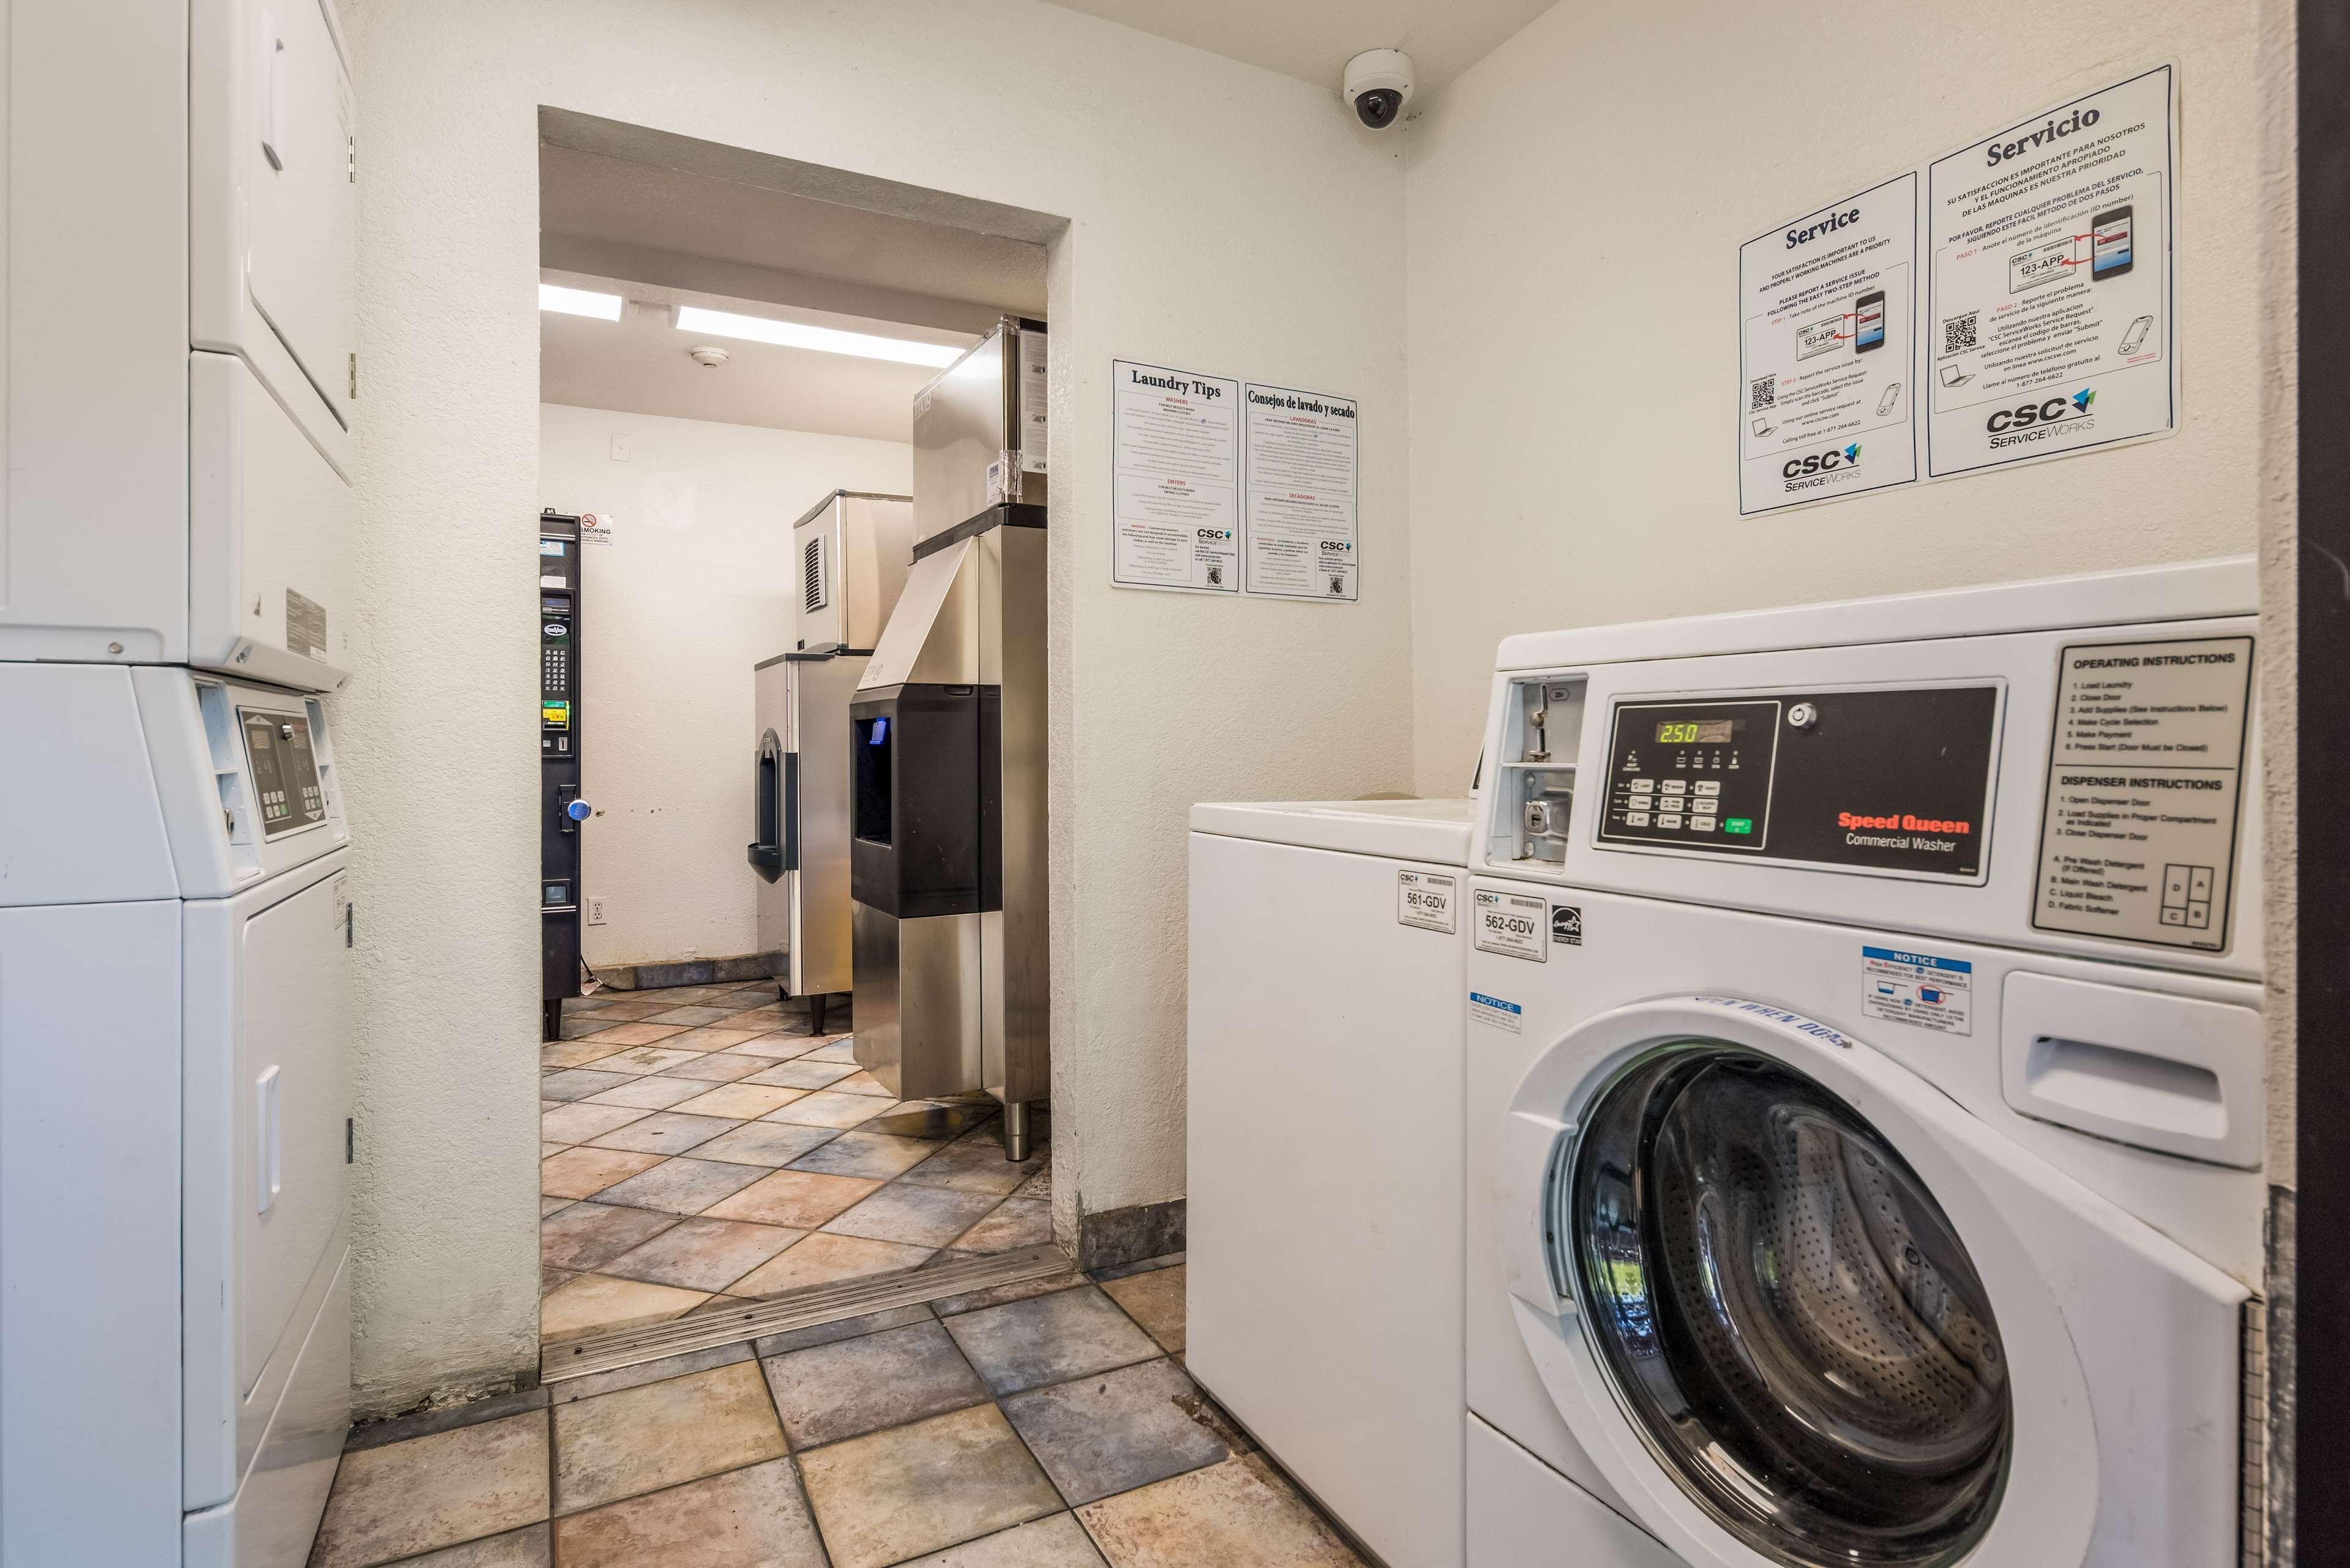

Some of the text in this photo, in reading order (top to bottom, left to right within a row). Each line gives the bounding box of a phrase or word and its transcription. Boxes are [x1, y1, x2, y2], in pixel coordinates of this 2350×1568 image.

[1986, 109, 2100, 167] Servicio
[1947, 122, 2145, 206] SU SATISFACCION ES IMPORTANTE PARA NOSOTROS
[1963, 149, 2125, 217] DE LAS MAQUINAS ES NUESTRA PRIORIDAD
[1974, 146, 2111, 203] Y EL FUNCIONAMIENTO APROPIADO
[1949, 168, 2143, 243] POR FAVOR, REPORTE CUALQUIER PROBLEMA DEL SERVICIO,
[1967, 184, 2120, 244] SIGUIENDO ESTE FACIL METODO DE DOS PASOS
[1786, 209, 1860, 249] Service
[1759, 284, 1769, 293] AND
[1770, 275, 1794, 289] PROPERLY
[1795, 265, 1819, 279] WORKING
[1820, 255, 1847, 270] MACHINES
[1848, 250, 1858, 259] ARE
[1865, 238, 1891, 253] PRIORITY
[1772, 271, 1784, 280] YOUR
[1785, 257, 1821, 275] SATISFACTION
[1827, 243, 1858, 259] IMPORTANT
[2011, 255, 2027, 264] CSC
[2020, 255, 2064, 275] 123-APP
[1767, 272, 1880, 316] FOLLOWING THE EASY TWO-STEP METHOD
[1779, 293, 1797, 305] PLEASE
[1798, 285, 1819, 297] REPORT
[1825, 275, 1847, 288] SERVICE
[1849, 269, 1866, 280] ISSUE
[1772, 316, 1782, 325] STEP
[1825, 296, 1847, 307] machine
[1853, 286, 1876, 297] number
[1805, 330, 1836, 346] 123-APP
[1983, 381, 2000, 389] Llame
[2007, 373, 2032, 383] número
[2041, 365, 2065, 375] teléfono
[2067, 358, 2092, 370] gratuito
[2016, 372, 2063, 388] 1-877-264-6622
[1132, 370, 1221, 400] Laundry Tips
[1248, 390, 1355, 419] Consejos de lavado y secado
[1836, 401, 1855, 410] request
[1802, 413, 1839, 426] www.cscsw.com
[1986, 397, 2067, 433] CSC
[1823, 420, 1860, 433] 1-877-264-6622
[1783, 450, 1840, 479] CSC
[1197, 529, 1224, 539] CSC
[1320, 541, 1344, 551] CSC
[2074, 654, 2235, 668] OPERATING INSTRUCTIONS
[2101, 681, 2133, 689] Laundry
[2095, 706, 2127, 714] Supplies
[2128, 706, 2148, 714] (See
[2175, 744, 2208, 753] Closed)
[2061, 776, 2222, 790] DISPENSER INSTRUCTIONS
[1838, 812, 1970, 834] Speed Queen
[1846, 833, 1956, 852] Commercial Washer
[1407, 893, 1446, 909] 561-GDV
[1486, 915, 1535, 934] 562-GDV
[1894, 953, 1937, 966] NOTICE
[1477, 995, 1514, 1011] NOTICE
[1738, 1004, 1800, 1023] WHEN
